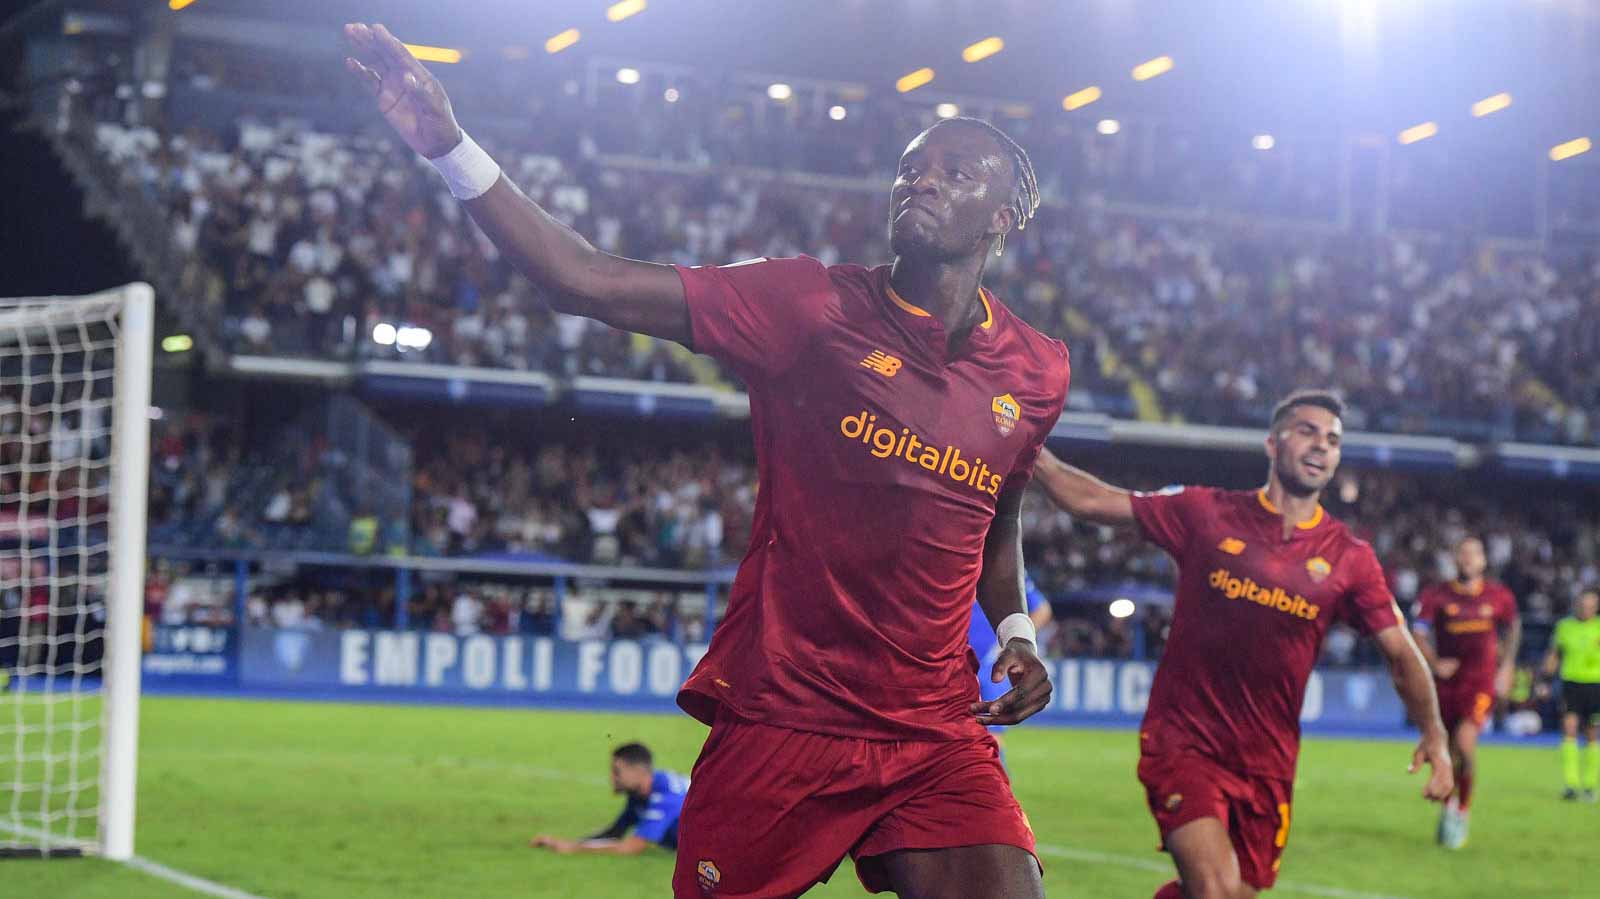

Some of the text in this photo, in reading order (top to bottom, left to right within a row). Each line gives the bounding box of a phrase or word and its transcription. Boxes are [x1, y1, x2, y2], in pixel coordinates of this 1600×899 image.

[840, 411, 1002, 495] digitalbits
[1208, 568, 1320, 620] digitalbits
[340, 629, 555, 691] EMPOLI
